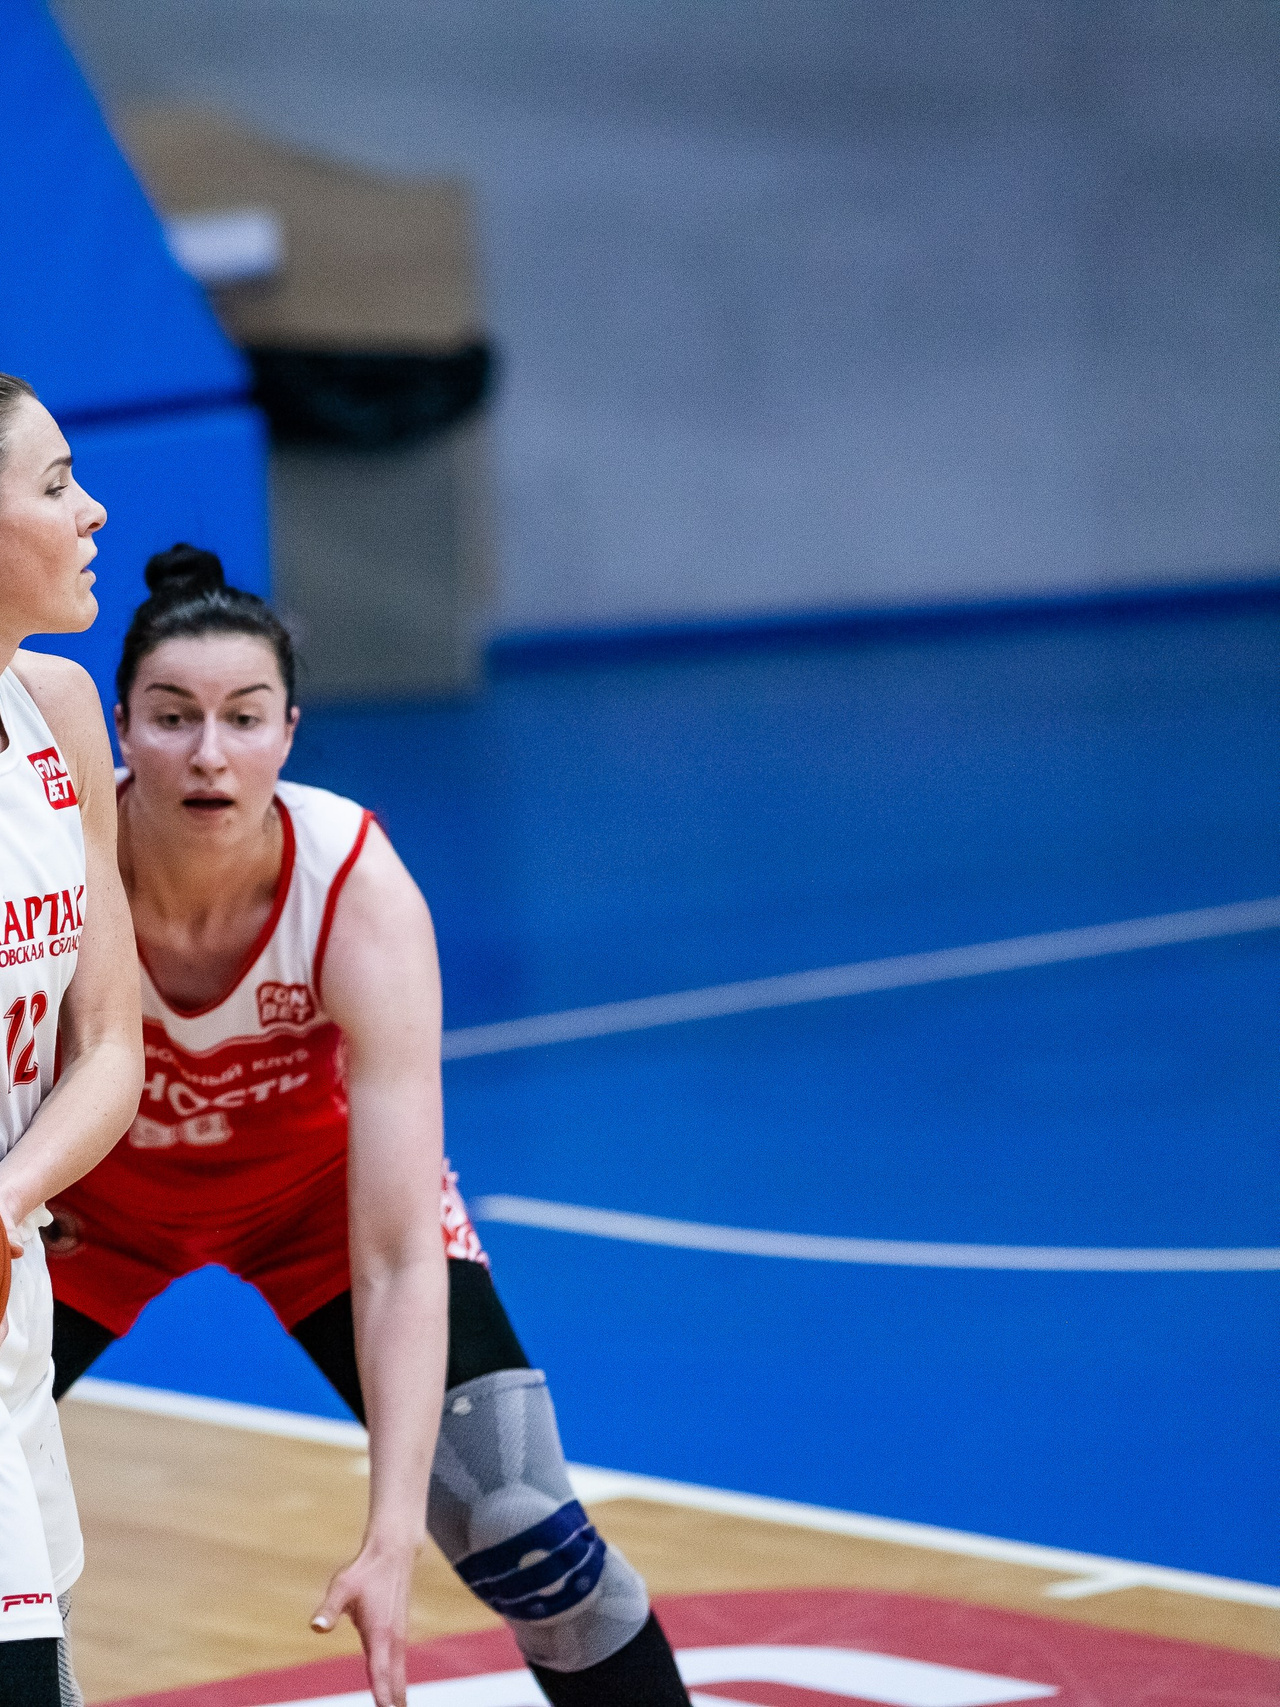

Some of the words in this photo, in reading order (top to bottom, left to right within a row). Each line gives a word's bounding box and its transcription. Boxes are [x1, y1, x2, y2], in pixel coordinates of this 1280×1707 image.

[260, 985, 309, 1006] FON
[261, 1003, 312, 1023] BET
[3, 989, 49, 1095] 12
[143, 1071, 310, 1117] НОСТЬ
